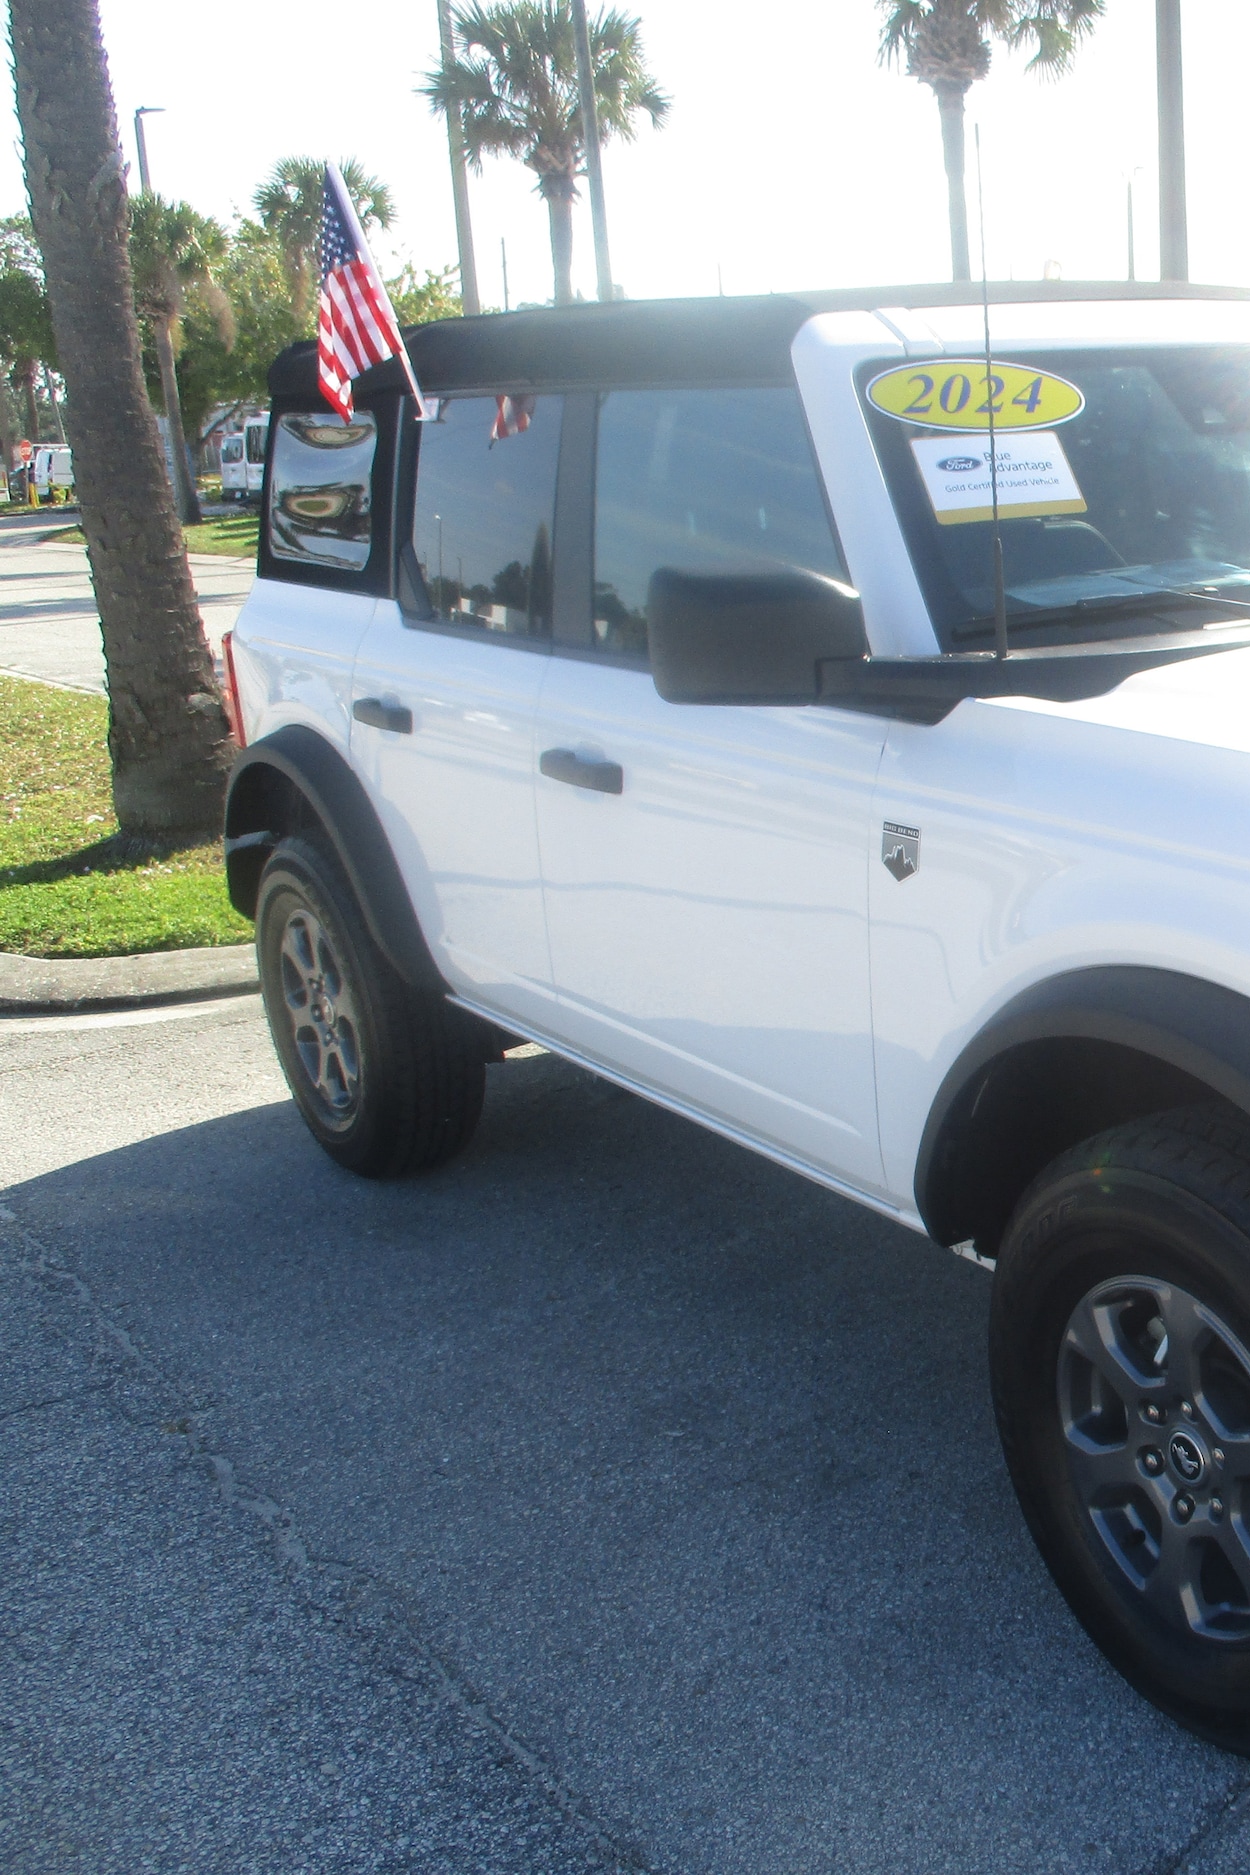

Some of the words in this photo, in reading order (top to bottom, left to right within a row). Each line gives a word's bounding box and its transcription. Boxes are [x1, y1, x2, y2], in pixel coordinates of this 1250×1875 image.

[903, 374, 1042, 414] 2024
[983, 451, 1011, 461] Bue
[945, 459, 973, 470] Ford
[989, 460, 1053, 473] Advantage
[945, 485, 966, 493] Gold
[968, 480, 1004, 490] Certifd
[1006, 479, 1028, 488] Used
[1030, 476, 1060, 487] Vehicle
[884, 823, 897, 832] BIG
